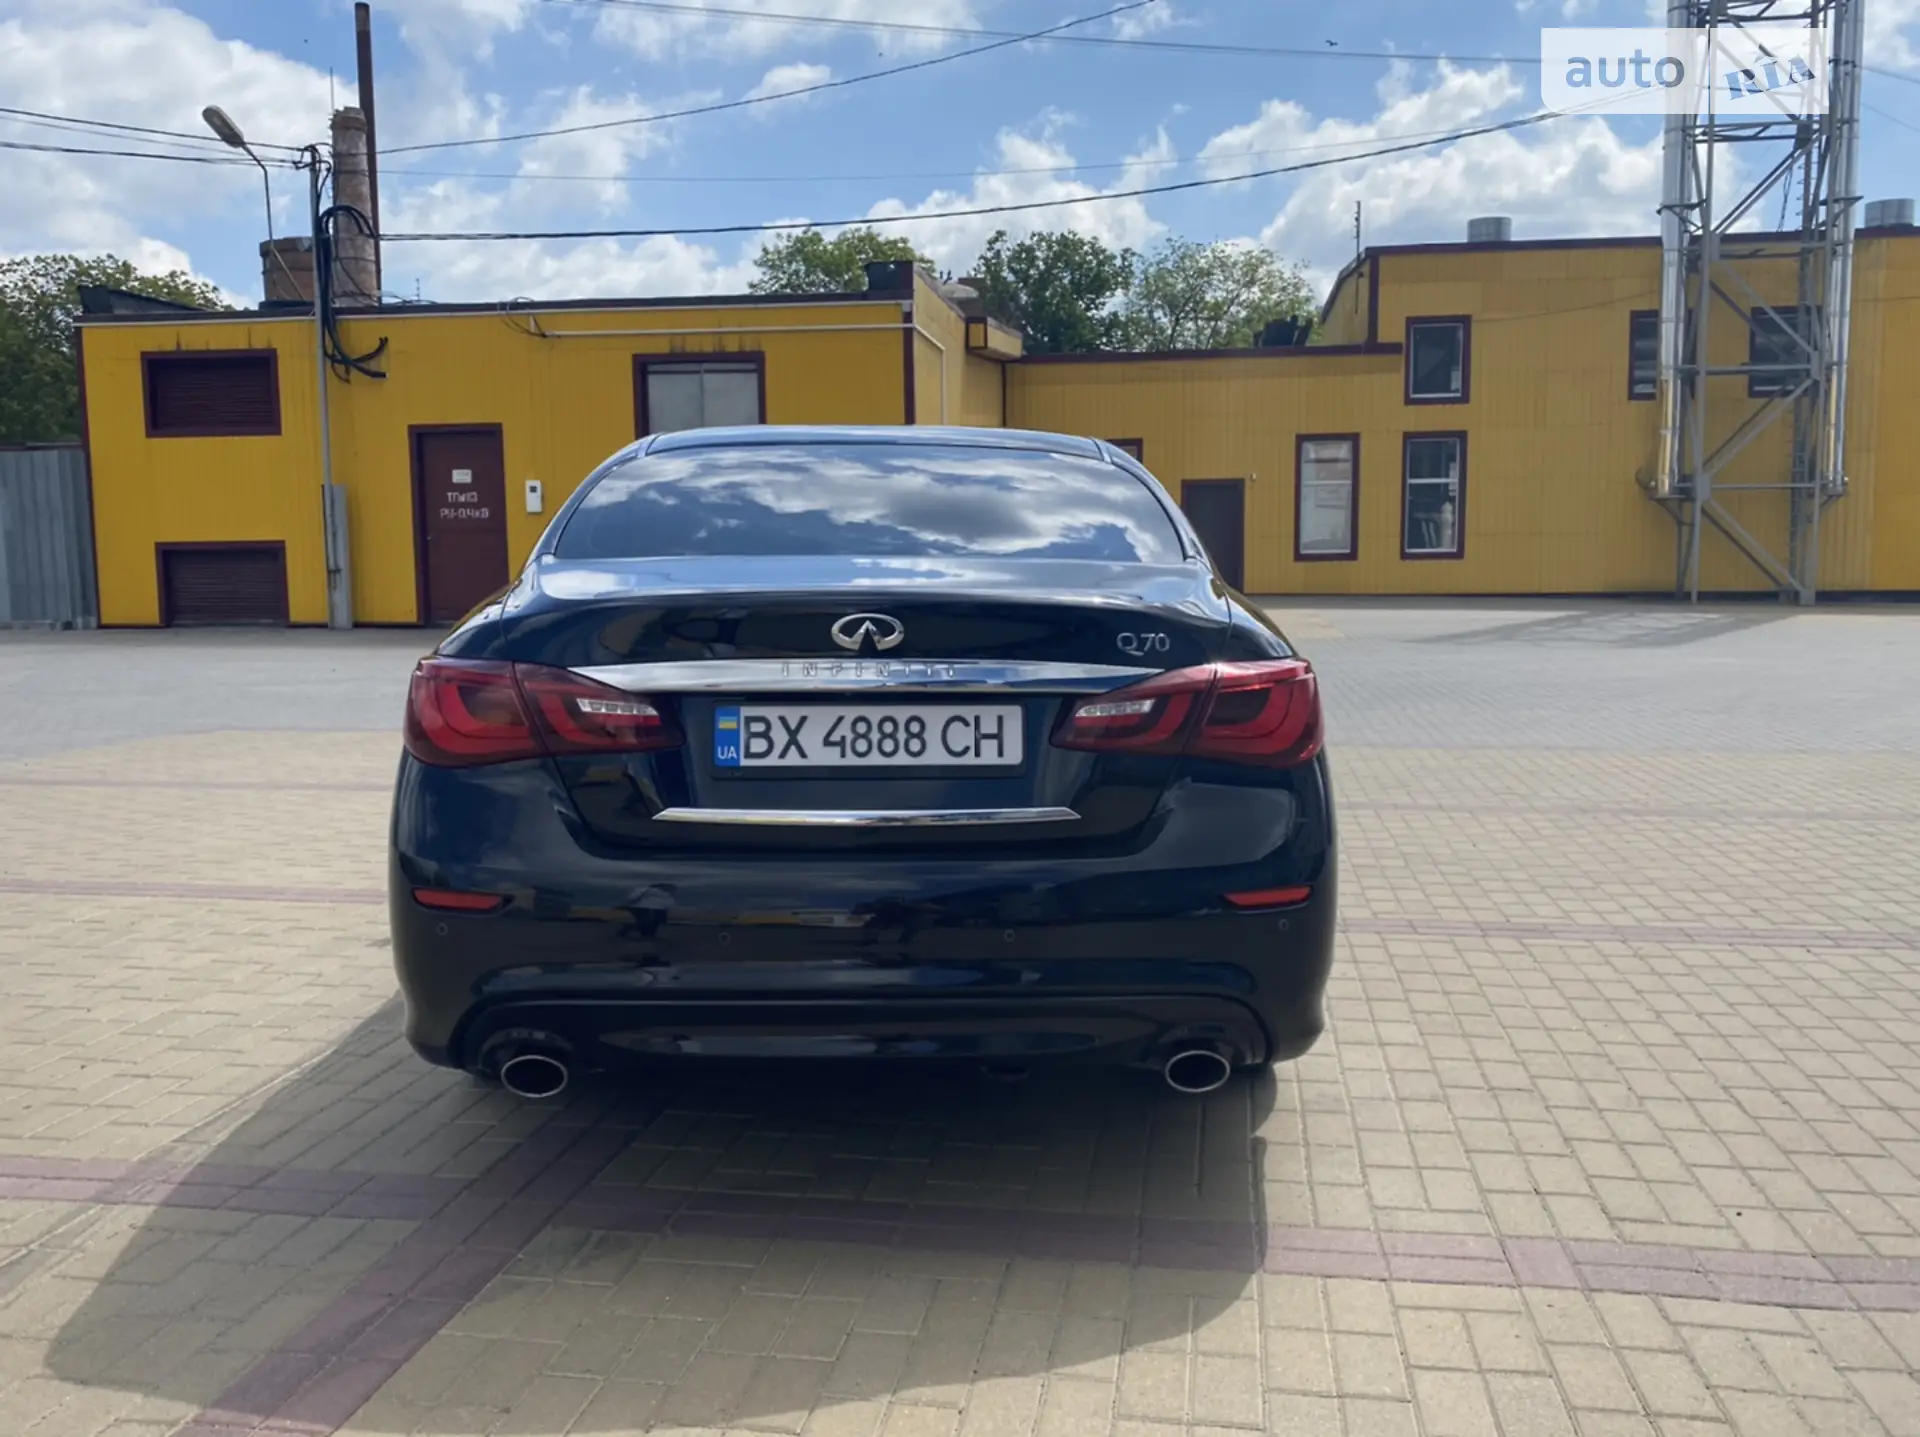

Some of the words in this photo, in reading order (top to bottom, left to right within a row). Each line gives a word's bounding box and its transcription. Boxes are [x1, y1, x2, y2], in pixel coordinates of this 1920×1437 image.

[1116, 632, 1170, 656] Q70
[782, 662, 956, 678] INFINITI
[743, 715, 808, 759] BX
[822, 715, 927, 758] 4888
[941, 715, 1004, 758] CH
[717, 746, 737, 760] UA
